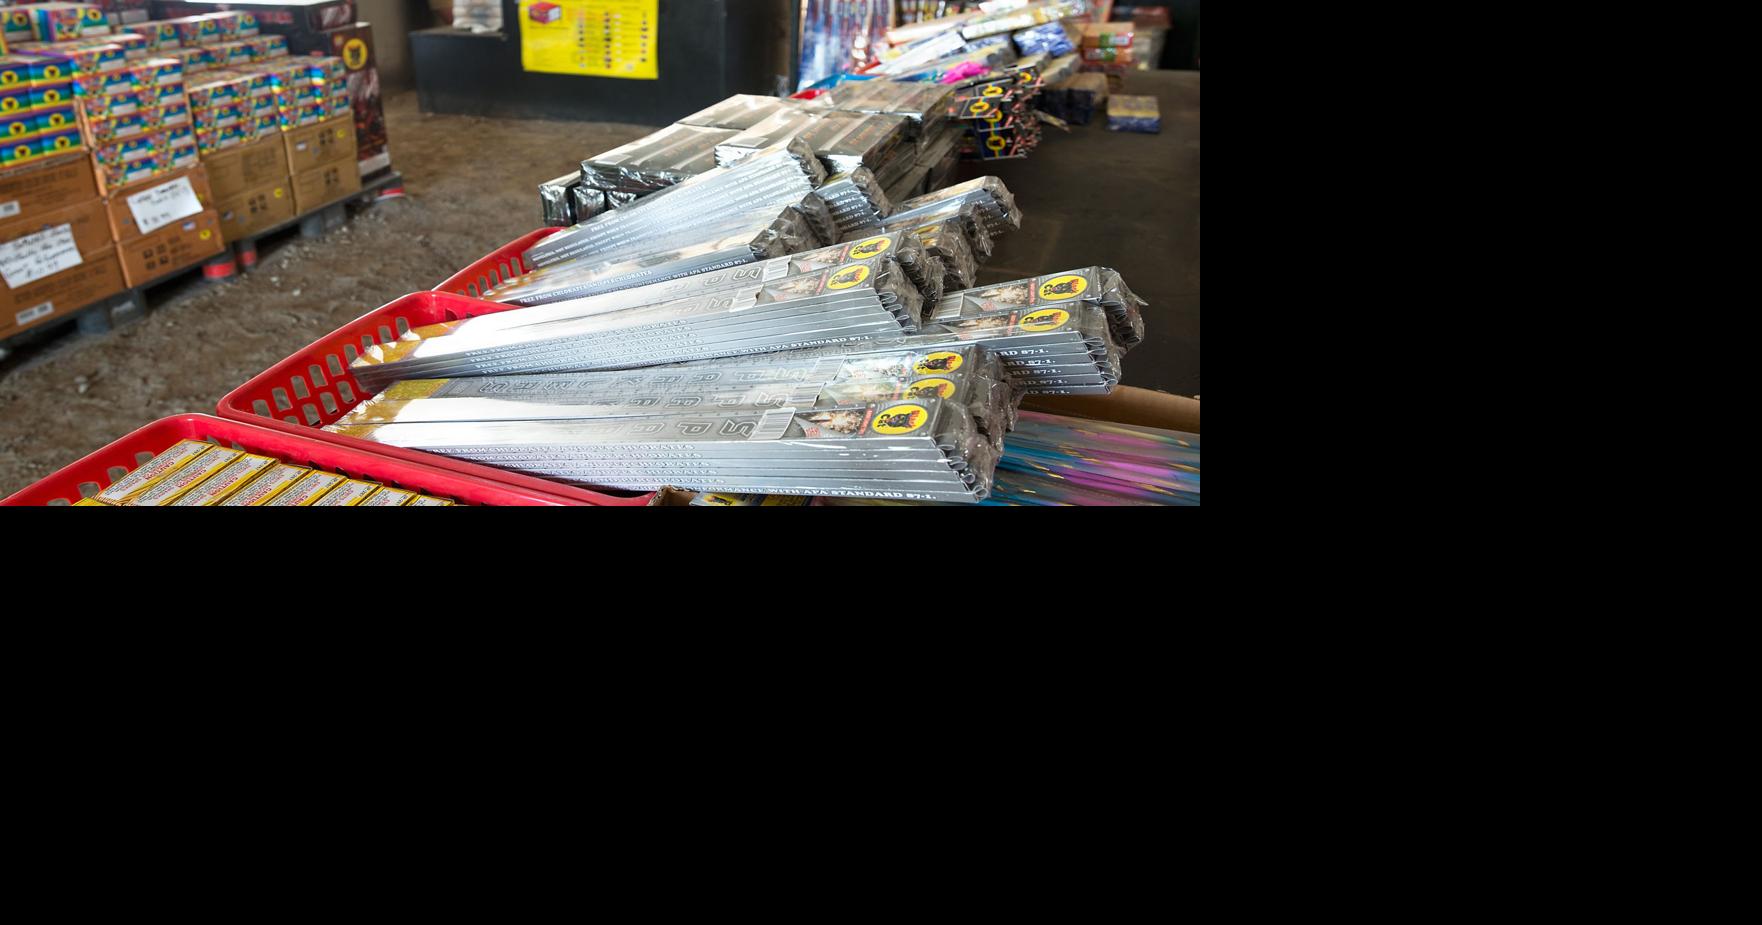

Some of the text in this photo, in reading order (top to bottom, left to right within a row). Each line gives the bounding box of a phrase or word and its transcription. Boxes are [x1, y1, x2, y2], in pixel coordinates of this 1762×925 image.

[701, 261, 733, 272] STANDARD
[1043, 284, 1055, 296] Cat
[519, 296, 535, 304] FREE
[535, 292, 552, 300] FROM
[790, 338, 847, 349] STANDARD
[877, 414, 892, 428] Cat
[908, 409, 921, 429] Black
[143, 461, 175, 480] CAUTION
[177, 469, 207, 488] CAUTION
[208, 477, 239, 496] CAUTION
[767, 487, 801, 495] WITH
[831, 490, 902, 498] STANDARD
